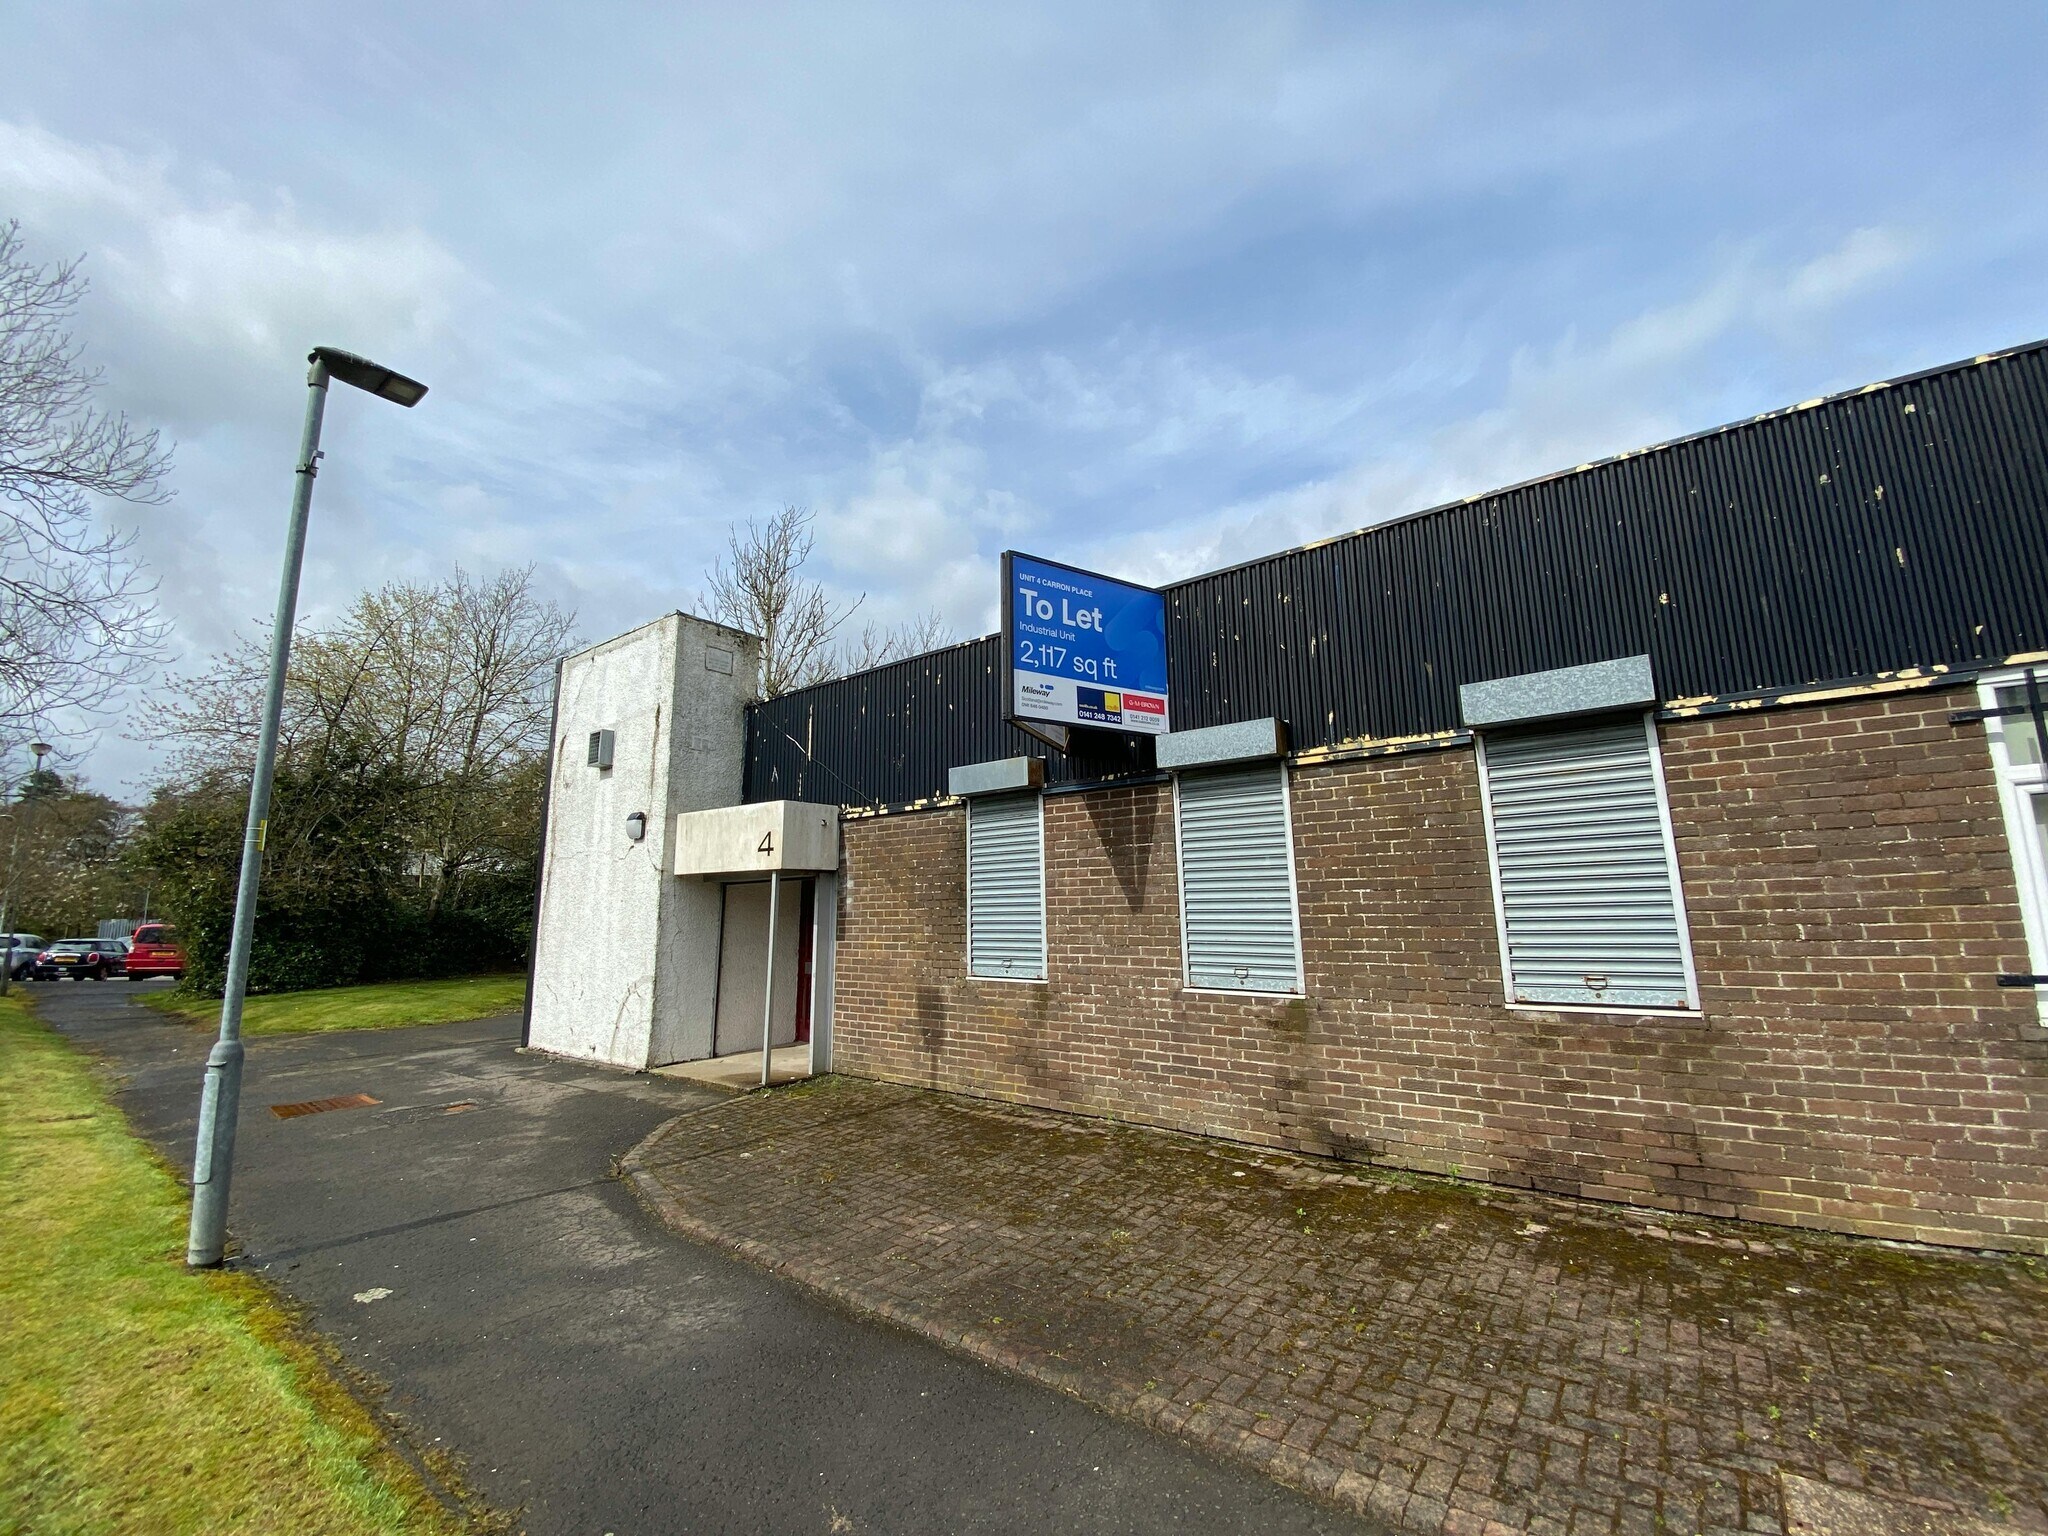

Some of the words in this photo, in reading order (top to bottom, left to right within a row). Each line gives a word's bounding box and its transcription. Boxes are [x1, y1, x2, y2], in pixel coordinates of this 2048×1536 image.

[1019, 572, 1036, 583] UNIT
[1042, 579, 1071, 592] CARRON
[1071, 586, 1093, 598] PLACE
[1019, 587, 1054, 621] To
[1062, 598, 1103, 633] Let
[1019, 621, 1058, 638] Industrial
[1059, 630, 1076, 642] Unit
[1020, 640, 1067, 669] 2,117
[1073, 656, 1098, 681] sq
[1102, 657, 1118, 679] ft
[1021, 685, 1051, 698] Mileway
[1079, 710, 1093, 718] 0141
[1093, 712, 1106, 720] 248
[1106, 714, 1121, 723] 7342
[757, 831, 774, 857] 4
